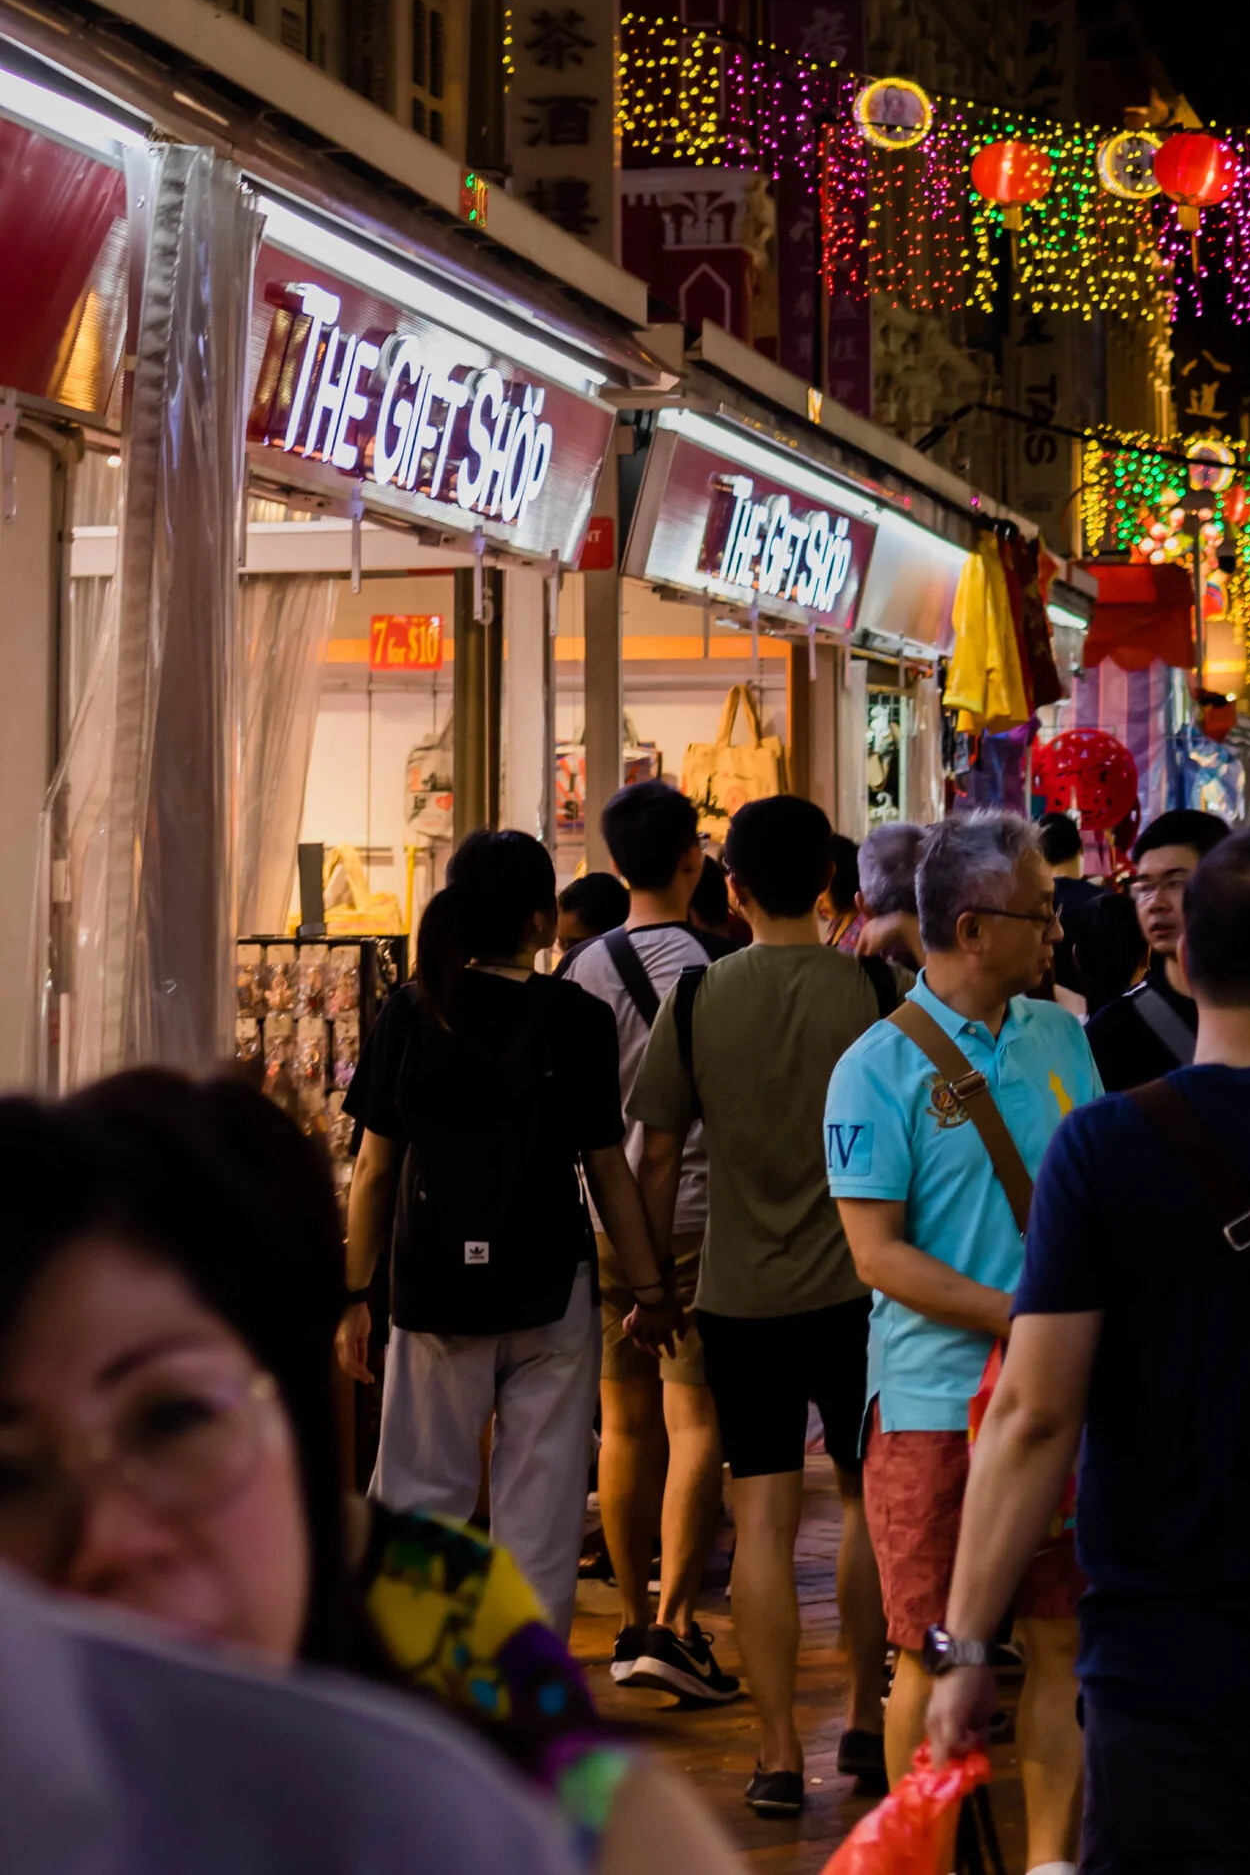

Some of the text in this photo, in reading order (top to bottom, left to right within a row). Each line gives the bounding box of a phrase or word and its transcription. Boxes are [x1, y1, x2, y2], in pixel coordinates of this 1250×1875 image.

[283, 282, 380, 471] THE
[373, 333, 470, 499] GIFT
[720, 474, 769, 588] THE
[758, 494, 810, 600] GIFT
[373, 617, 388, 663] 7
[826, 1123, 866, 1170] IV
